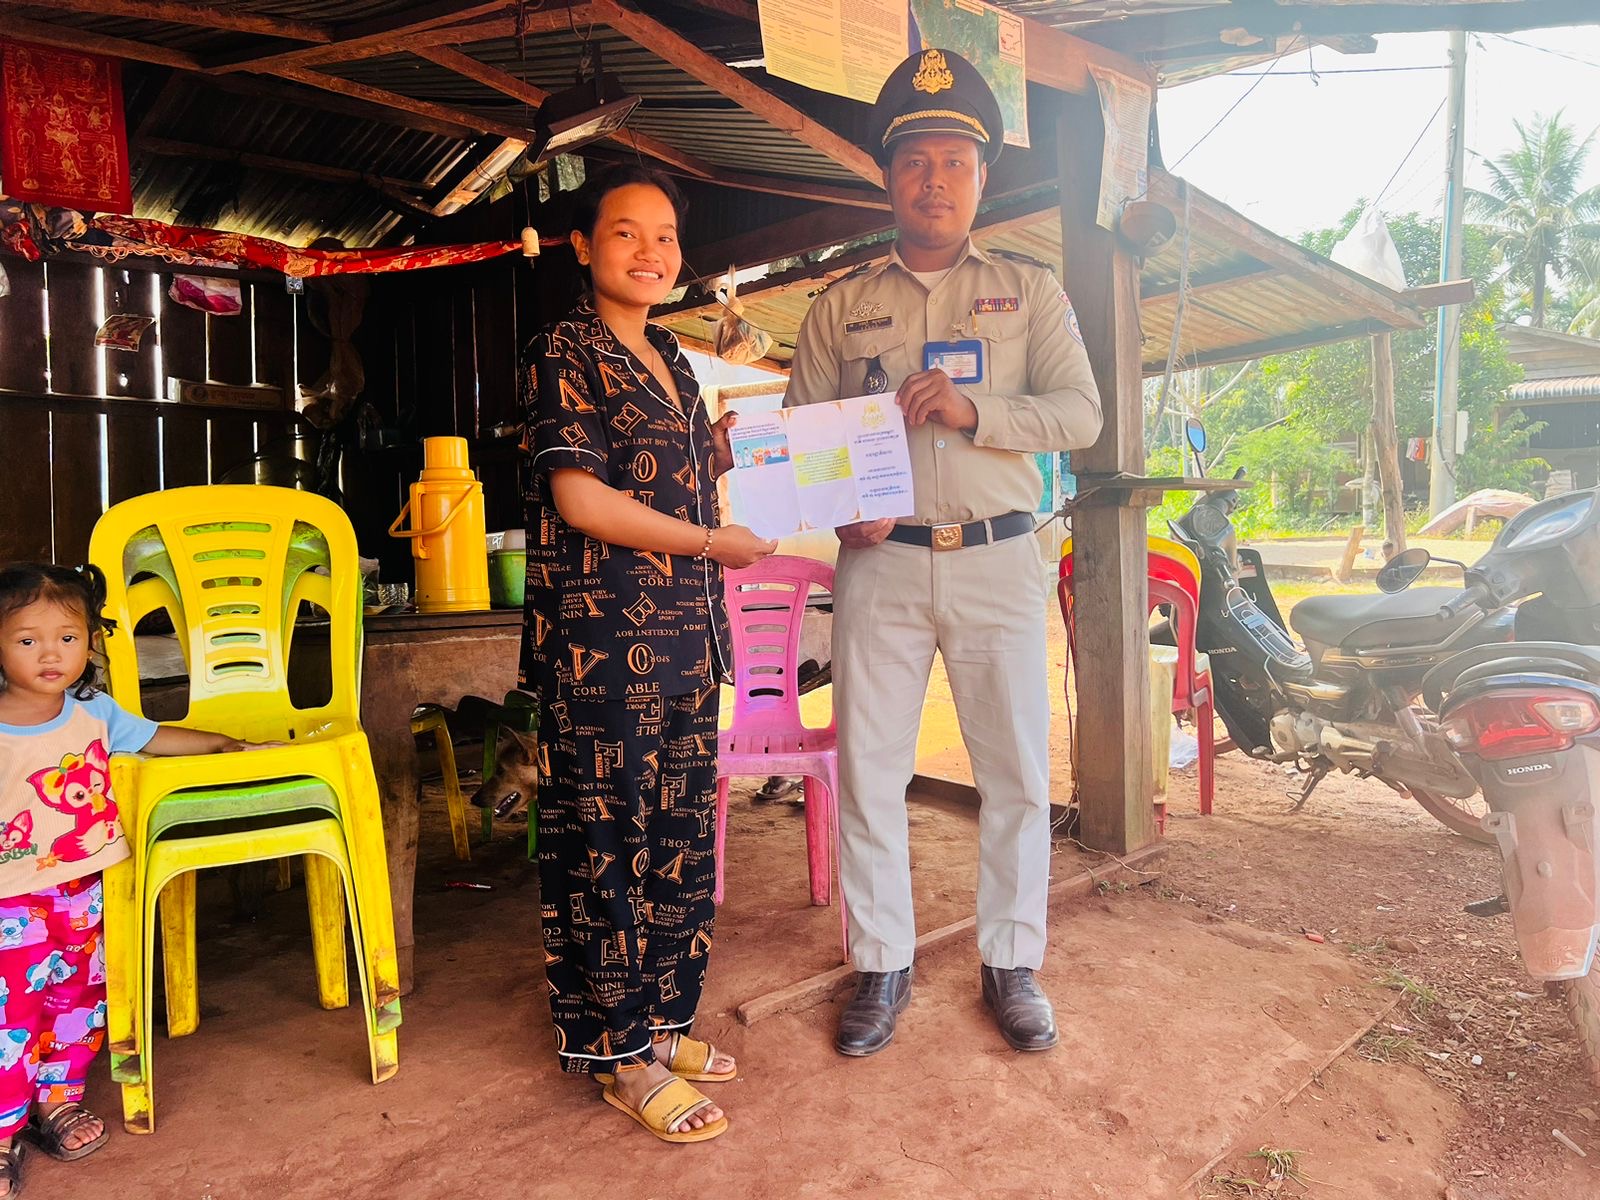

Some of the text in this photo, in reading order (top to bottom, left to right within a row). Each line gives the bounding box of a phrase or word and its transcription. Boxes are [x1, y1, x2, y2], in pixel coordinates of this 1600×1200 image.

[583, 577, 603, 586] BOY
[638, 577, 674, 588] CORE
[682, 623, 707, 631] ADMIT
[614, 629, 680, 638] EXCELLENT BOY
[572, 685, 608, 697] CORE
[625, 682, 661, 695] ABLE
[625, 703, 648, 711] SPORT
[575, 725, 606, 733] FASHION
[663, 760, 709, 770] EXCELLENT
[1507, 763, 1553, 776] HONDA
[596, 781, 614, 791] BOY
[659, 837, 691, 848] CORE
[658, 903, 687, 914] NINE
[563, 1011, 582, 1020] BOY
